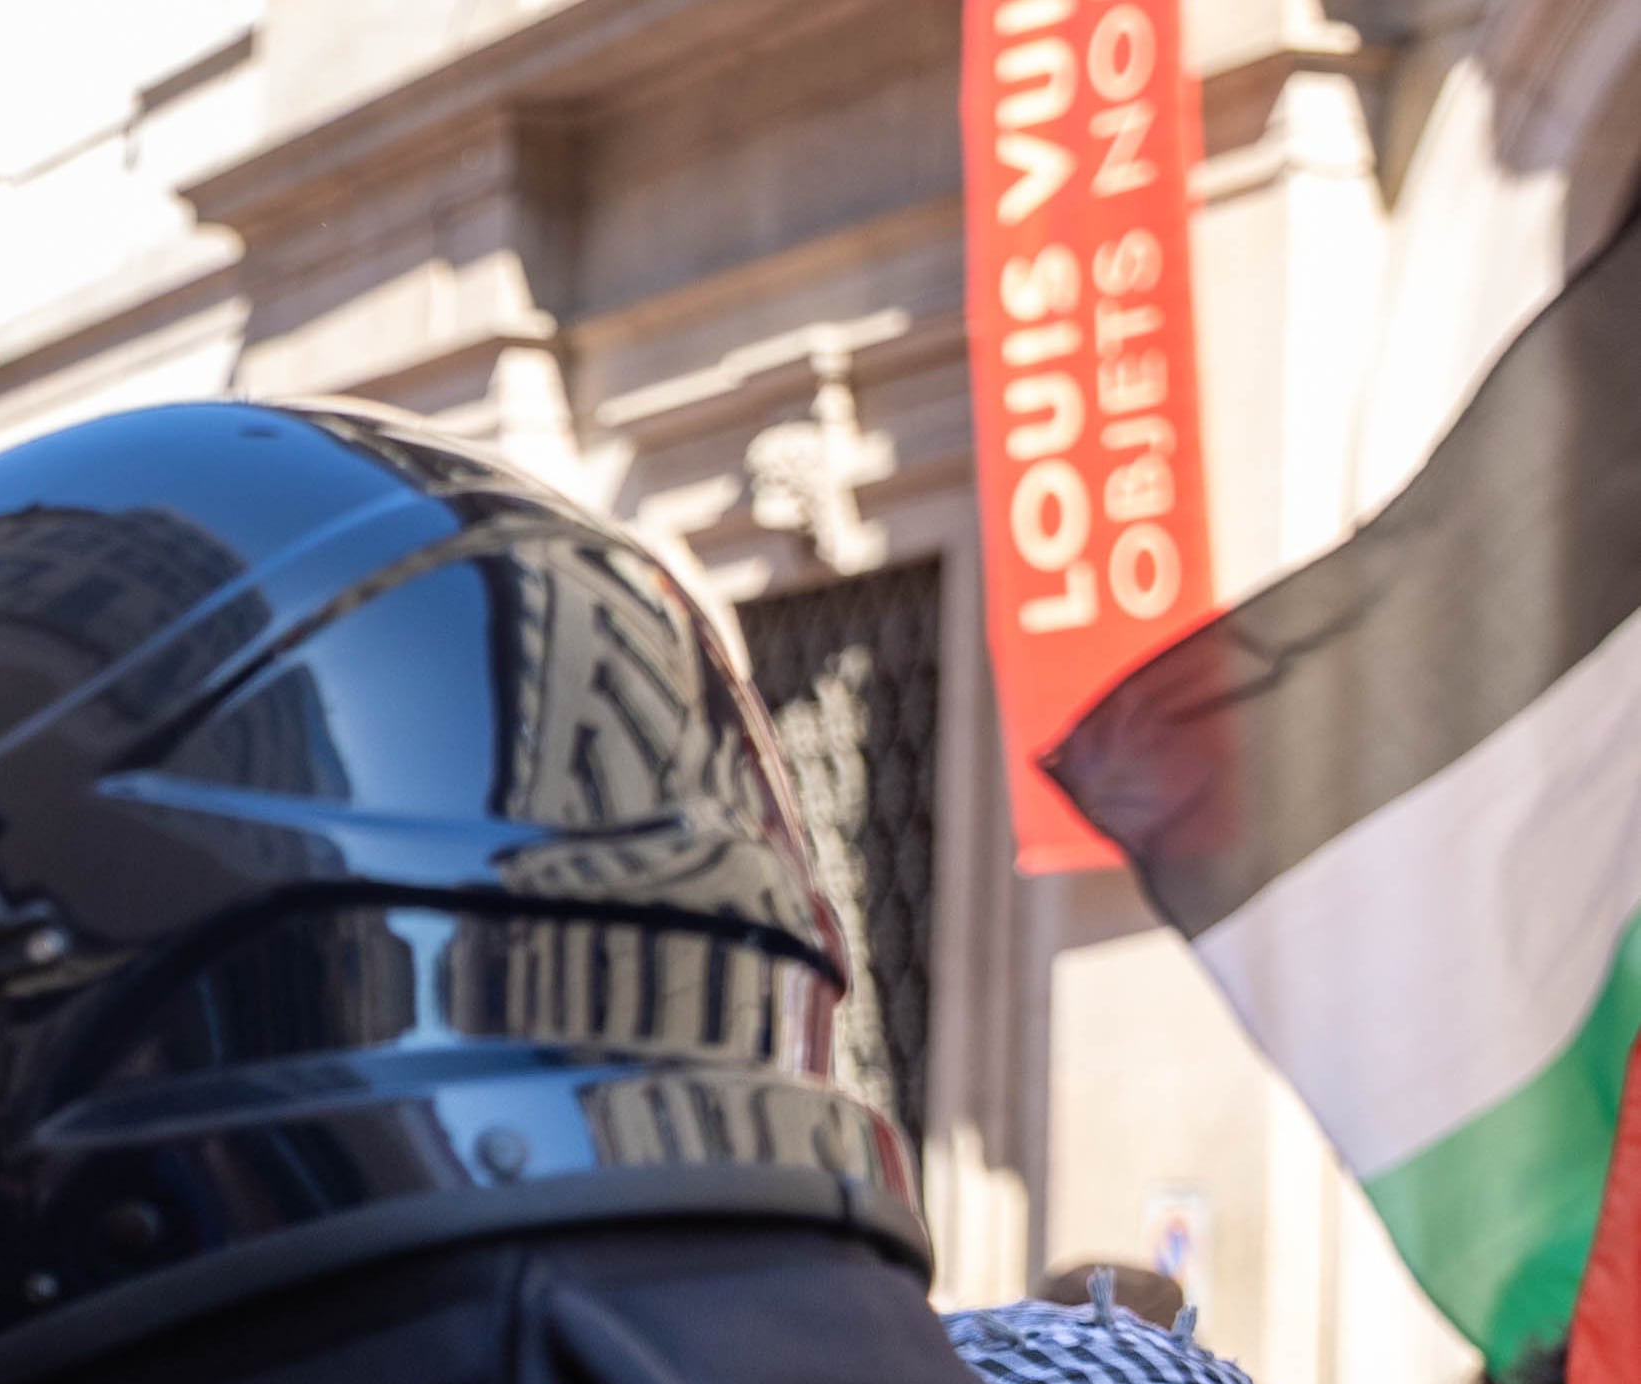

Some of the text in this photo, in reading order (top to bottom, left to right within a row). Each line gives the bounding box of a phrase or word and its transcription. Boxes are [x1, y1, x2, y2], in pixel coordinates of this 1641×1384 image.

[1000, 243, 1099, 634] LOUIS
[1088, 3, 1181, 620] OBJETS NO
